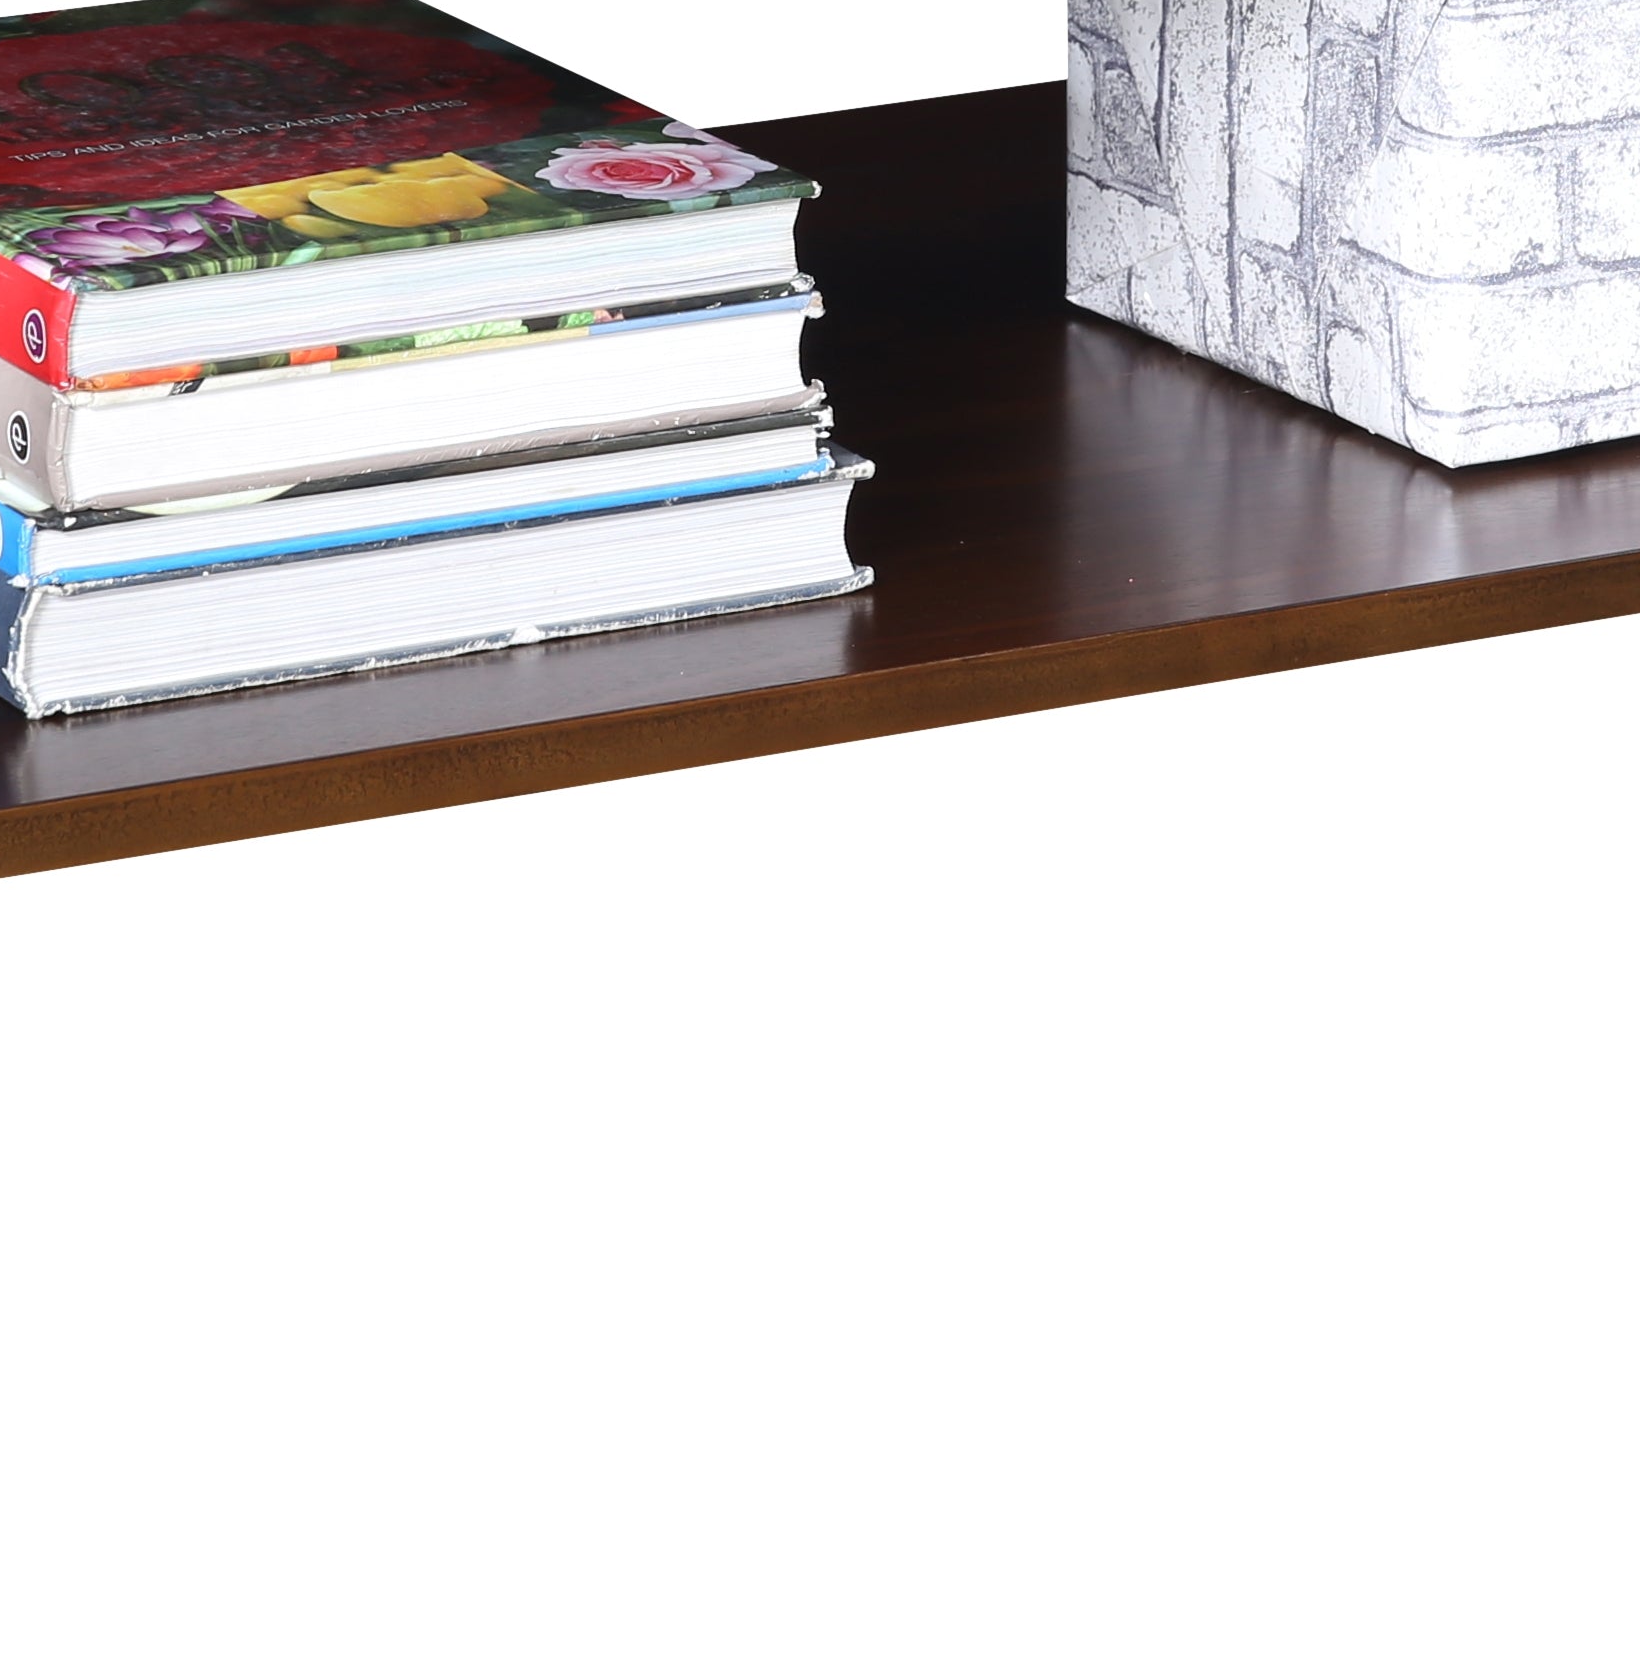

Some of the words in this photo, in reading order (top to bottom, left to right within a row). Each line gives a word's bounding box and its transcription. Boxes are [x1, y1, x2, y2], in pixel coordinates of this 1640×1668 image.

[8, 149, 67, 163] TIPS
[74, 142, 125, 156] AND
[129, 132, 204, 148] IDEAS
[206, 124, 260, 139] FOR
[263, 111, 368, 131] GARDEN
[370, 99, 468, 118] LOVERS
